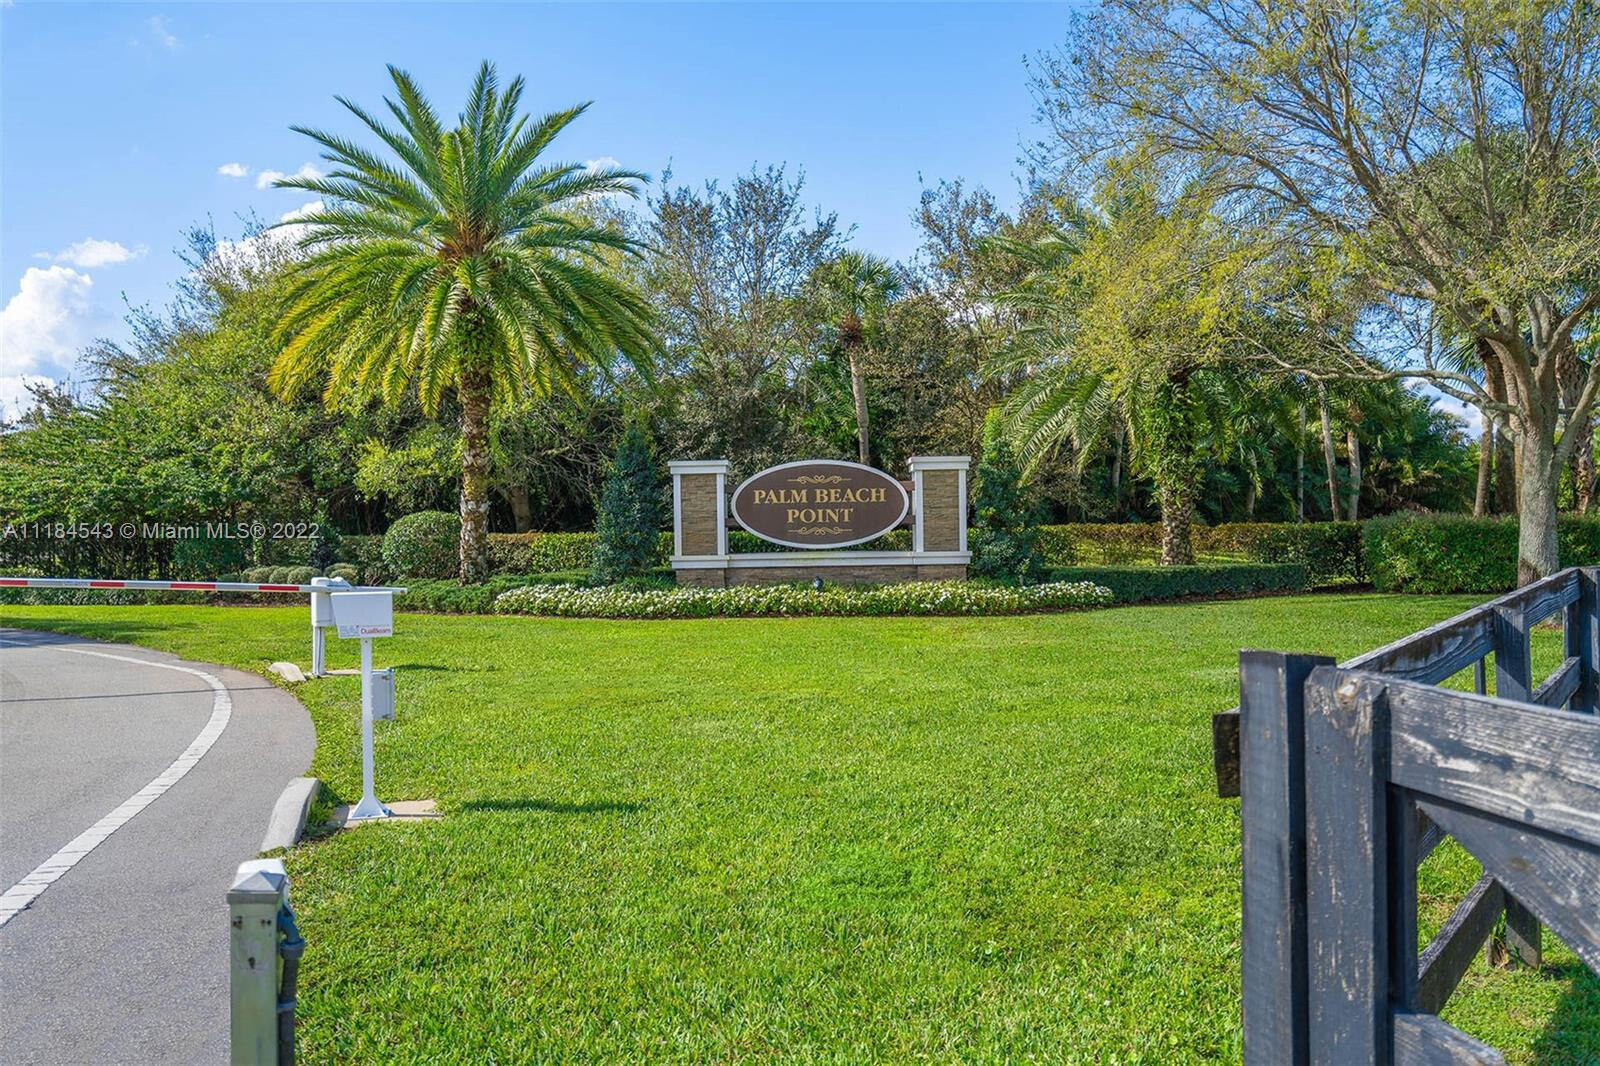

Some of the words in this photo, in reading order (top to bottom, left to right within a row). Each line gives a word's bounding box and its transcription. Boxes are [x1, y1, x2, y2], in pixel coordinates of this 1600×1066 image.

[753, 489, 808, 504] PALM
[815, 488, 887, 503] BEACH
[787, 508, 853, 523] POINT
